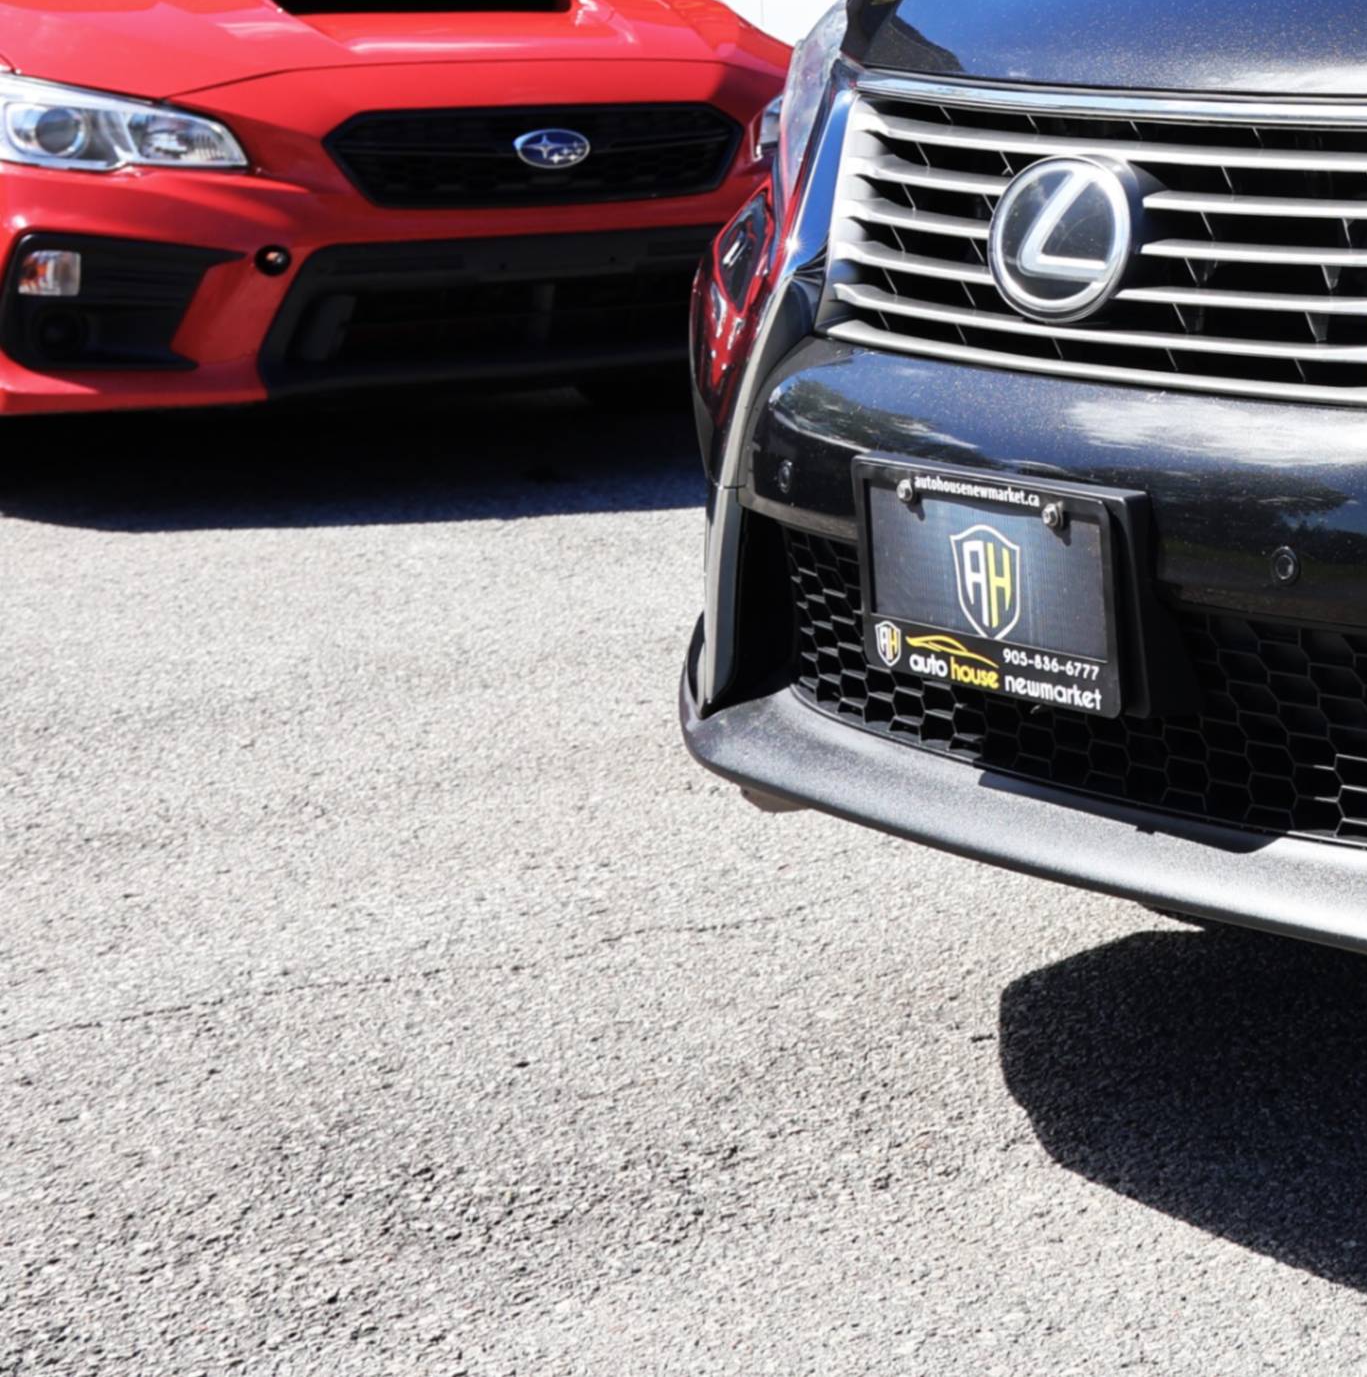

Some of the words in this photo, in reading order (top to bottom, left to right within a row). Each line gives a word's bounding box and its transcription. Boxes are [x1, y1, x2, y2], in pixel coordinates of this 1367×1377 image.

[914, 475, 1040, 508] autohousenewmarket.ca
[963, 539, 1012, 629] AH
[909, 653, 949, 678] auto
[950, 656, 999, 690] house
[1004, 674, 1102, 710] newmarket
[1002, 648, 1100, 681] 905-836-6777
